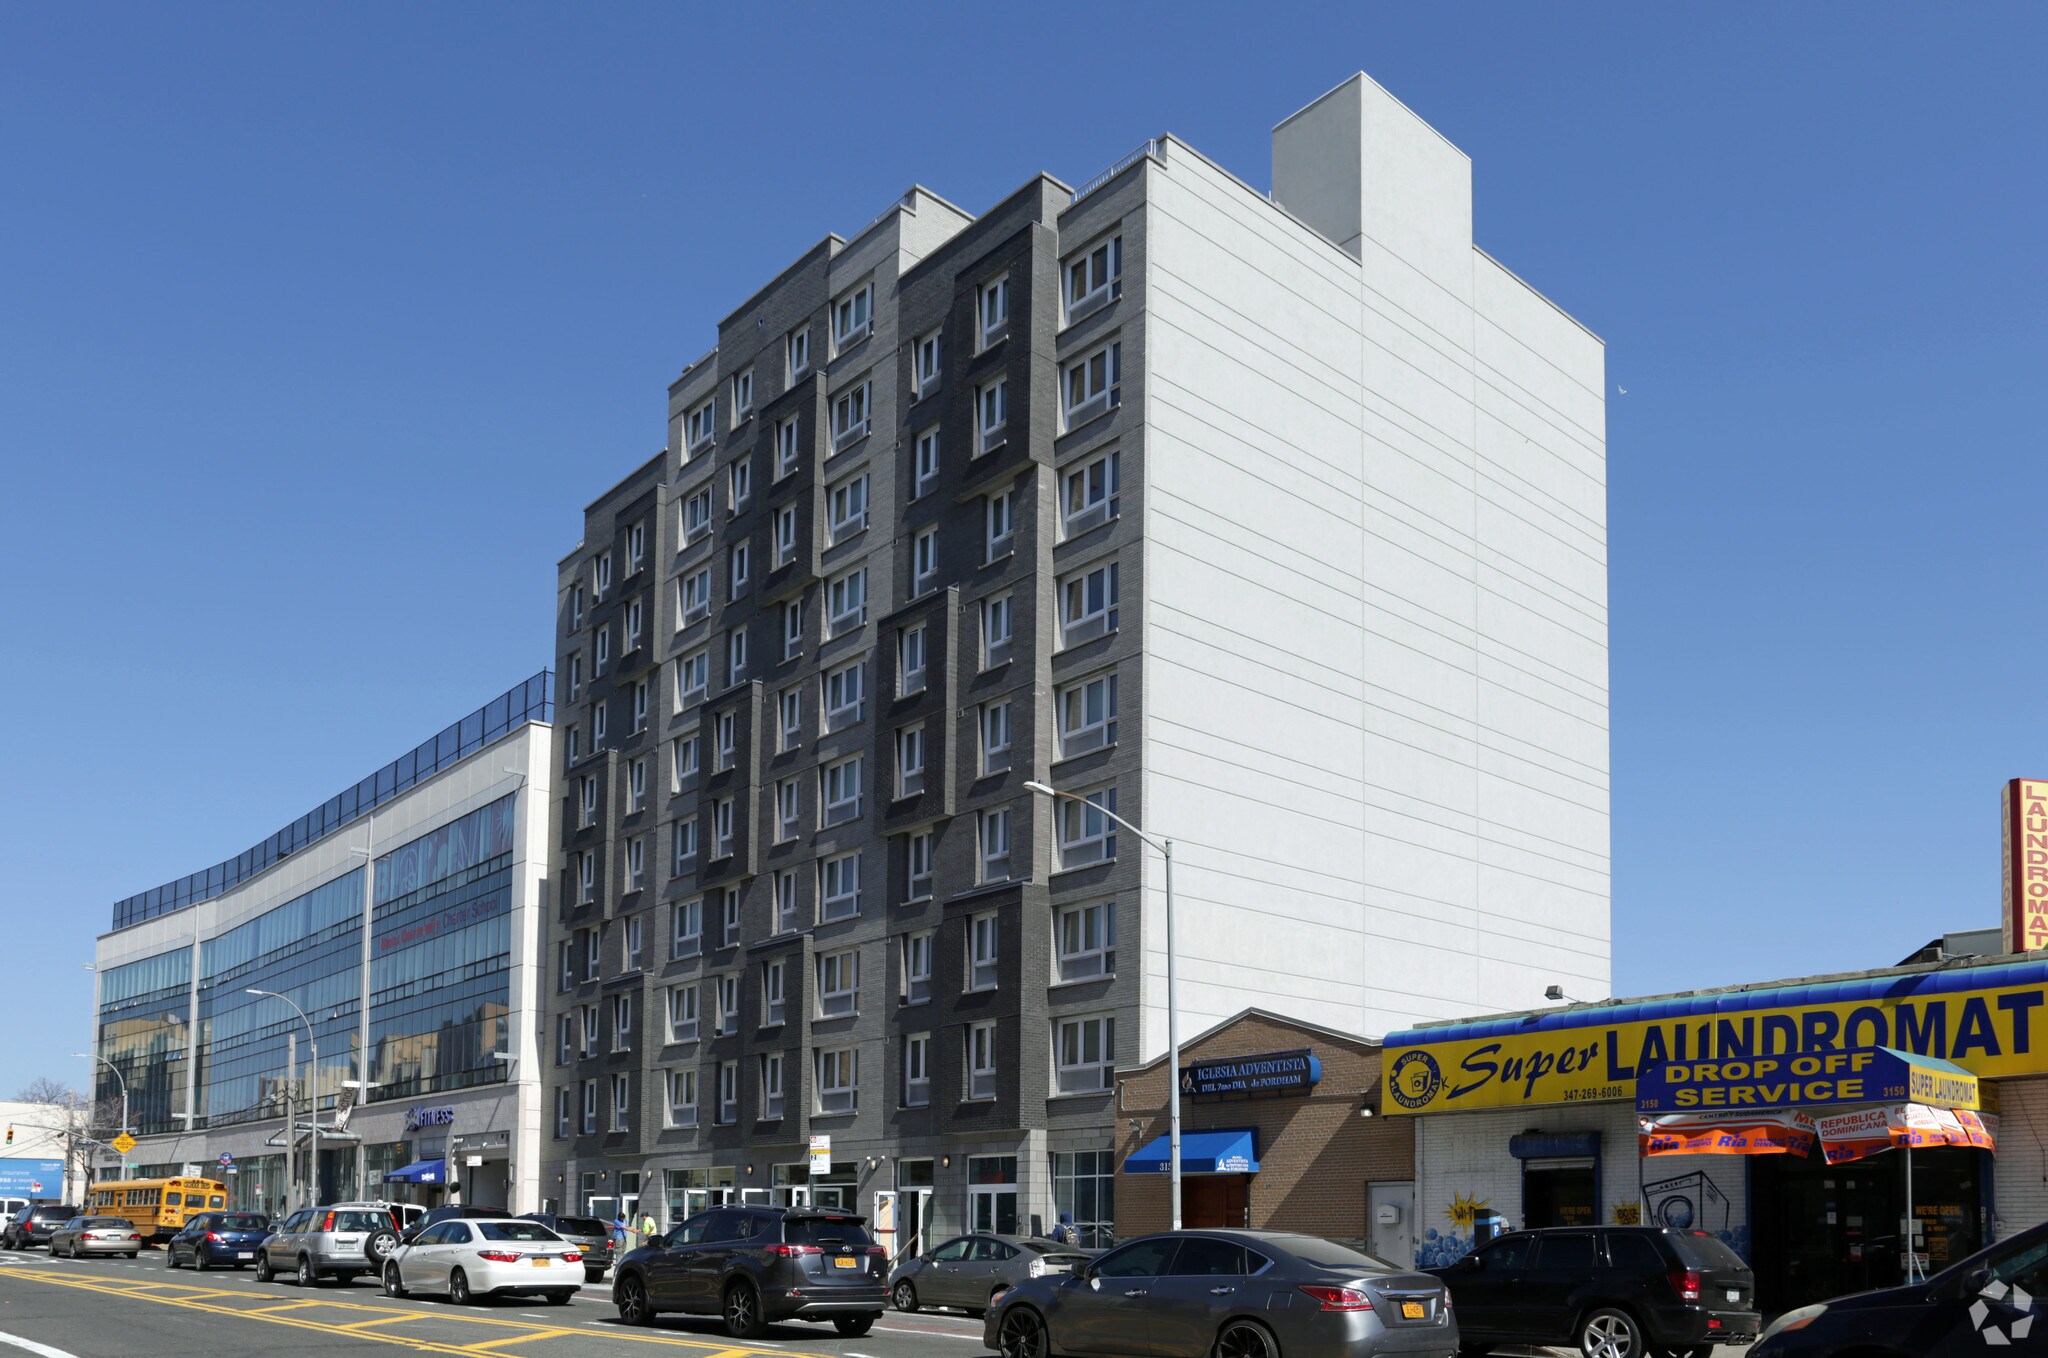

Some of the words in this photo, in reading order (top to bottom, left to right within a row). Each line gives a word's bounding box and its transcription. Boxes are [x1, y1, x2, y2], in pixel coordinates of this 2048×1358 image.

[2026, 785, 2048, 946] LAUNDROMAT
[471, 895, 498, 918] School
[1446, 1042, 1598, 1100] Super
[1606, 990, 2044, 1081] LAUNDROMAT
[1401, 1053, 1429, 1066] SUPER
[1665, 1060, 1779, 1083] DROP
[1790, 1052, 1875, 1076] OFF
[1197, 1064, 1237, 1080] IGLESIA
[1237, 1057, 1306, 1077] ADVENTISTA
[1202, 1083, 1216, 1092] DEL
[1232, 1081, 1246, 1089] DIA
[1251, 1079, 1260, 1087] de
[1260, 1075, 1302, 1087] FORDHAM
[1883, 1085, 1905, 1097] 3150
[1911, 1071, 1934, 1098] SUPER
[1935, 1077, 1976, 1104] LAUNDROMAT
[340, 1087, 356, 1115] Schoo
[1390, 1078, 1440, 1108] LAUNDROMAT
[1563, 1085, 1623, 1101] 347-269-6006
[1674, 1079, 1864, 1106] SERVICE
[1640, 1099, 1658, 1109] 3150
[420, 1107, 450, 1126] FITNESS
[1699, 1111, 1727, 1120] CENTRO
[1735, 1109, 1782, 1117] SUDAMERICA
[1821, 1111, 1887, 1129] REPUBLICA
[1822, 1120, 1888, 1137] DOMINICANA
[1898, 1129, 1923, 1145] Ria
[1651, 1136, 1679, 1150] Ria
[1718, 1132, 1748, 1147] Ria
[1826, 1145, 1854, 1161] Ria
[1454, 1206, 1475, 1221] WI-F
[1915, 1206, 1938, 1215] WE'RE
[1940, 1206, 1961, 1215] OPEN
